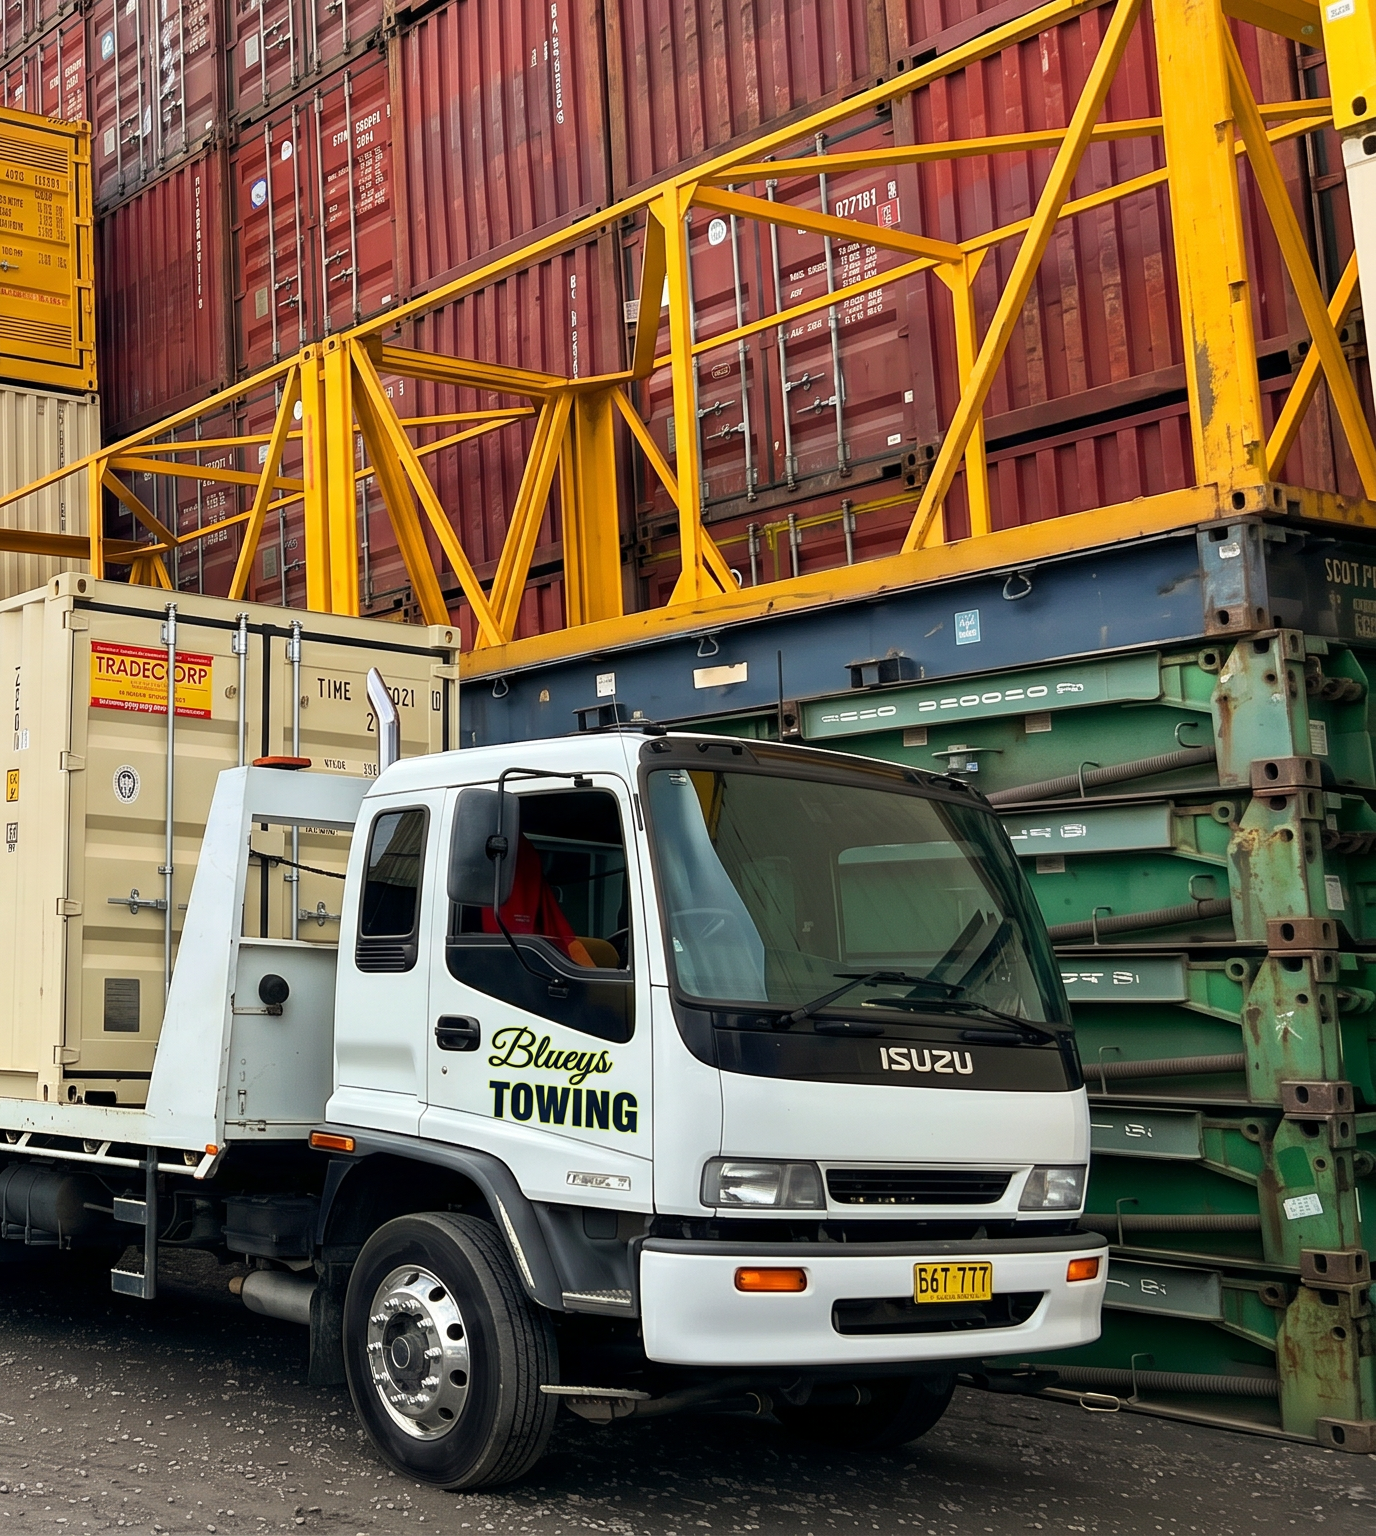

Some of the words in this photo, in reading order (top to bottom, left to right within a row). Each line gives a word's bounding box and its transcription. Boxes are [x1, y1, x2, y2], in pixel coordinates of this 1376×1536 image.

[96, 655, 208, 685] TRADECORP
[317, 678, 351, 701] TIME
[488, 1026, 613, 1085] Blueys
[880, 1047, 974, 1075] ISUZU
[489, 1080, 638, 1133] TOWING
[957, 1266, 988, 1294] 777
